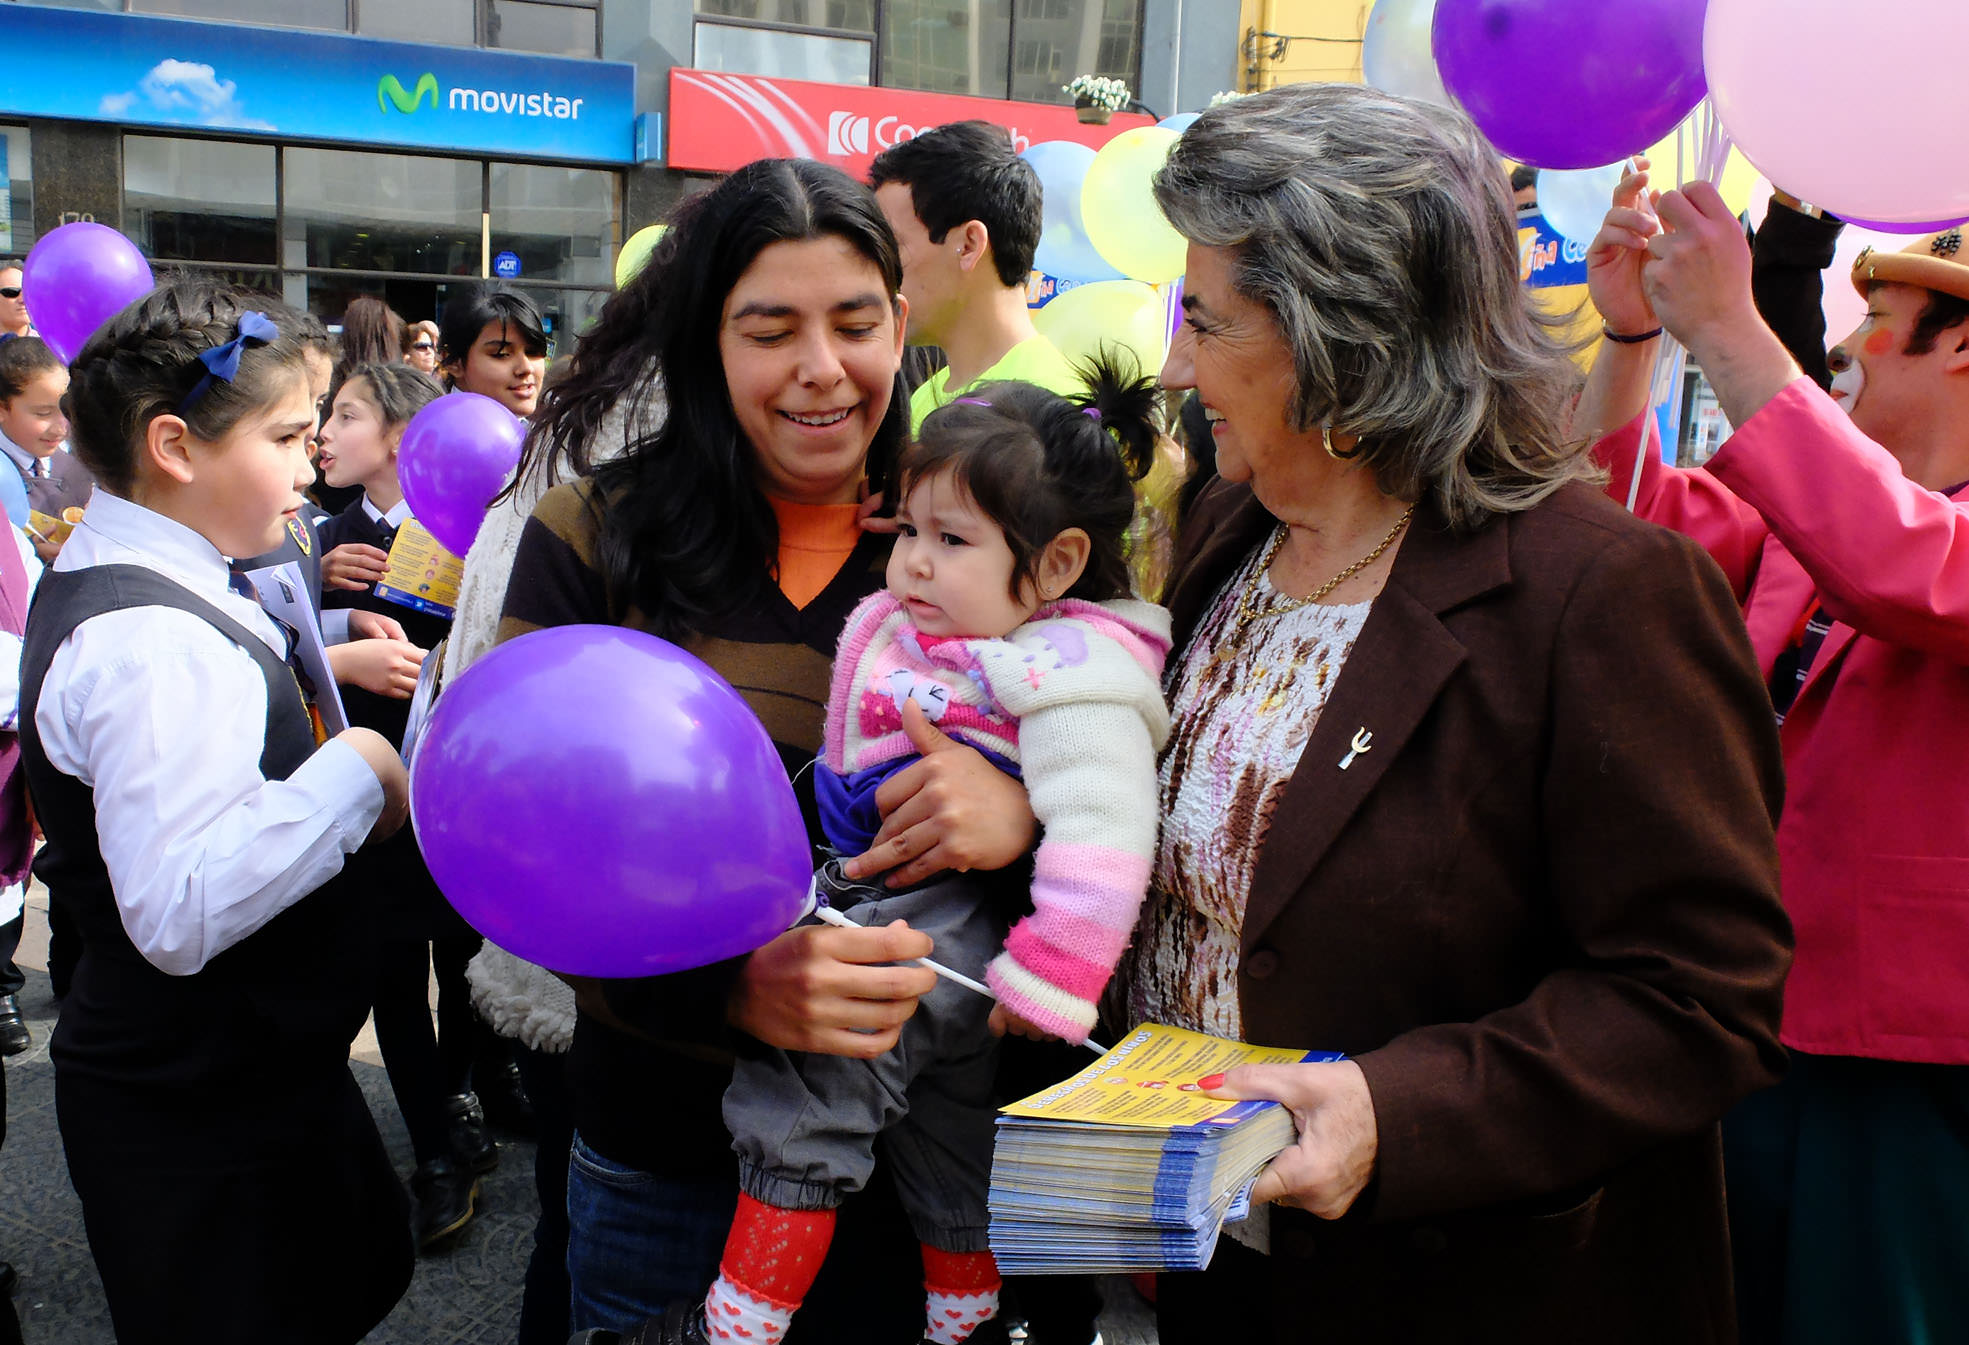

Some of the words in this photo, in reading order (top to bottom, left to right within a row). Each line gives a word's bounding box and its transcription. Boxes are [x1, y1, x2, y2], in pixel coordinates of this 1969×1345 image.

[449, 87, 583, 120] movistar
[498, 260, 517, 271] ADT
[1081, 1069, 1106, 1080] DE
[1096, 1055, 1125, 1070] LOS
